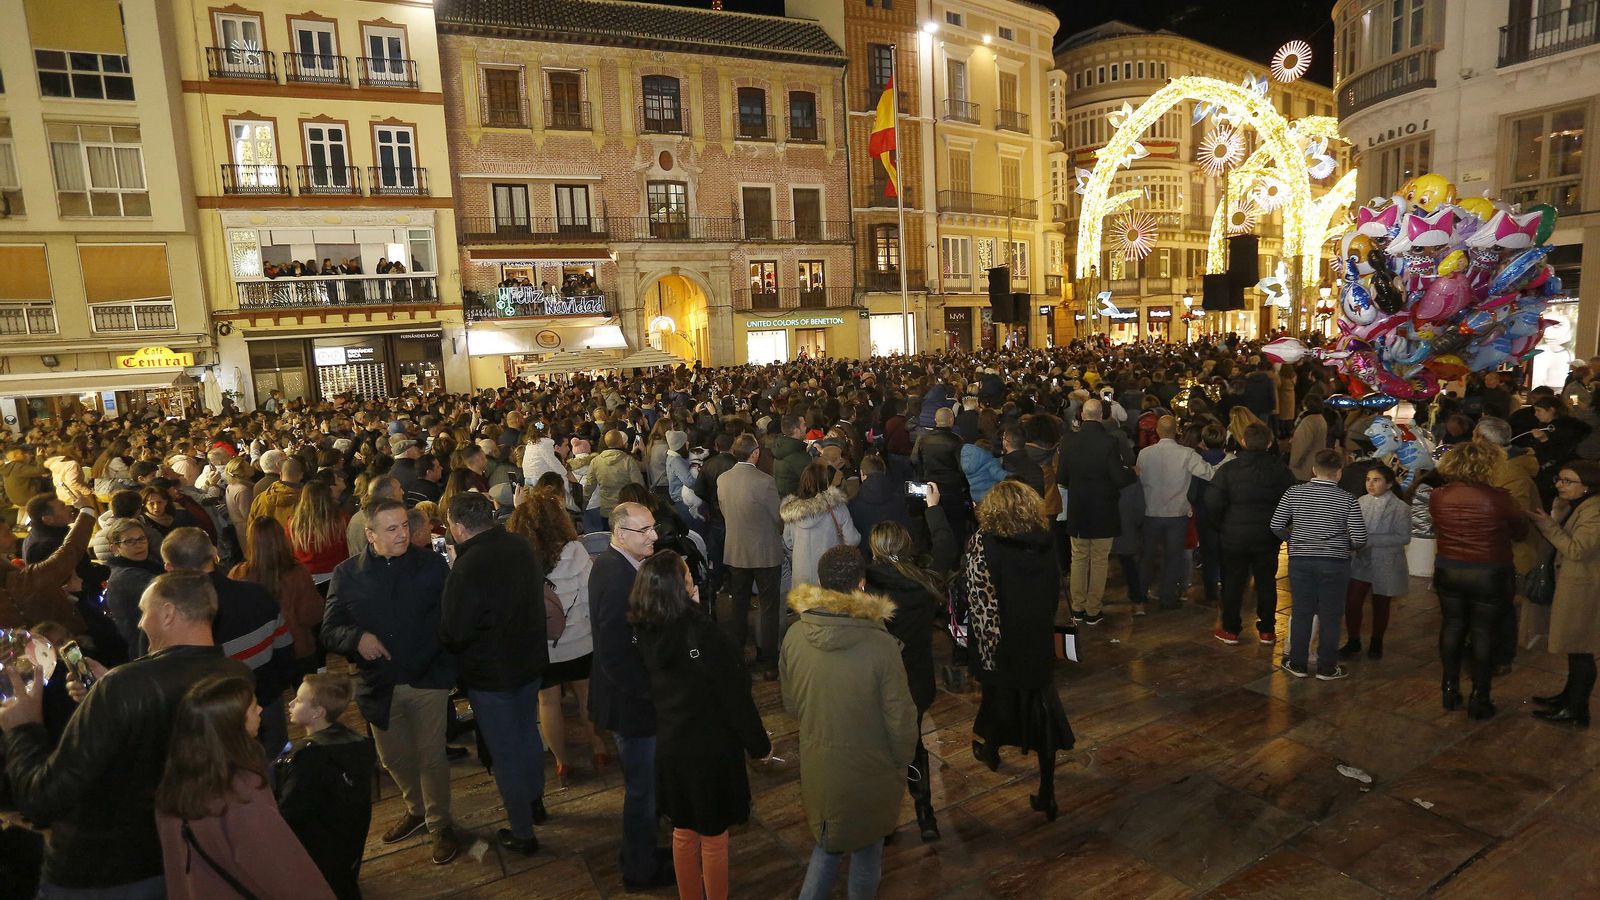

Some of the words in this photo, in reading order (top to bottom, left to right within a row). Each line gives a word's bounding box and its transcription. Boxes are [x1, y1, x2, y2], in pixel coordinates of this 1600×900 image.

[1368, 119, 1429, 147] LARIOS
[509, 286, 545, 304] Feliz
[544, 295, 606, 315] Navidad
[746, 320, 772, 328] UNITED
[800, 318, 809, 326] OF
[122, 356, 188, 368] Central
